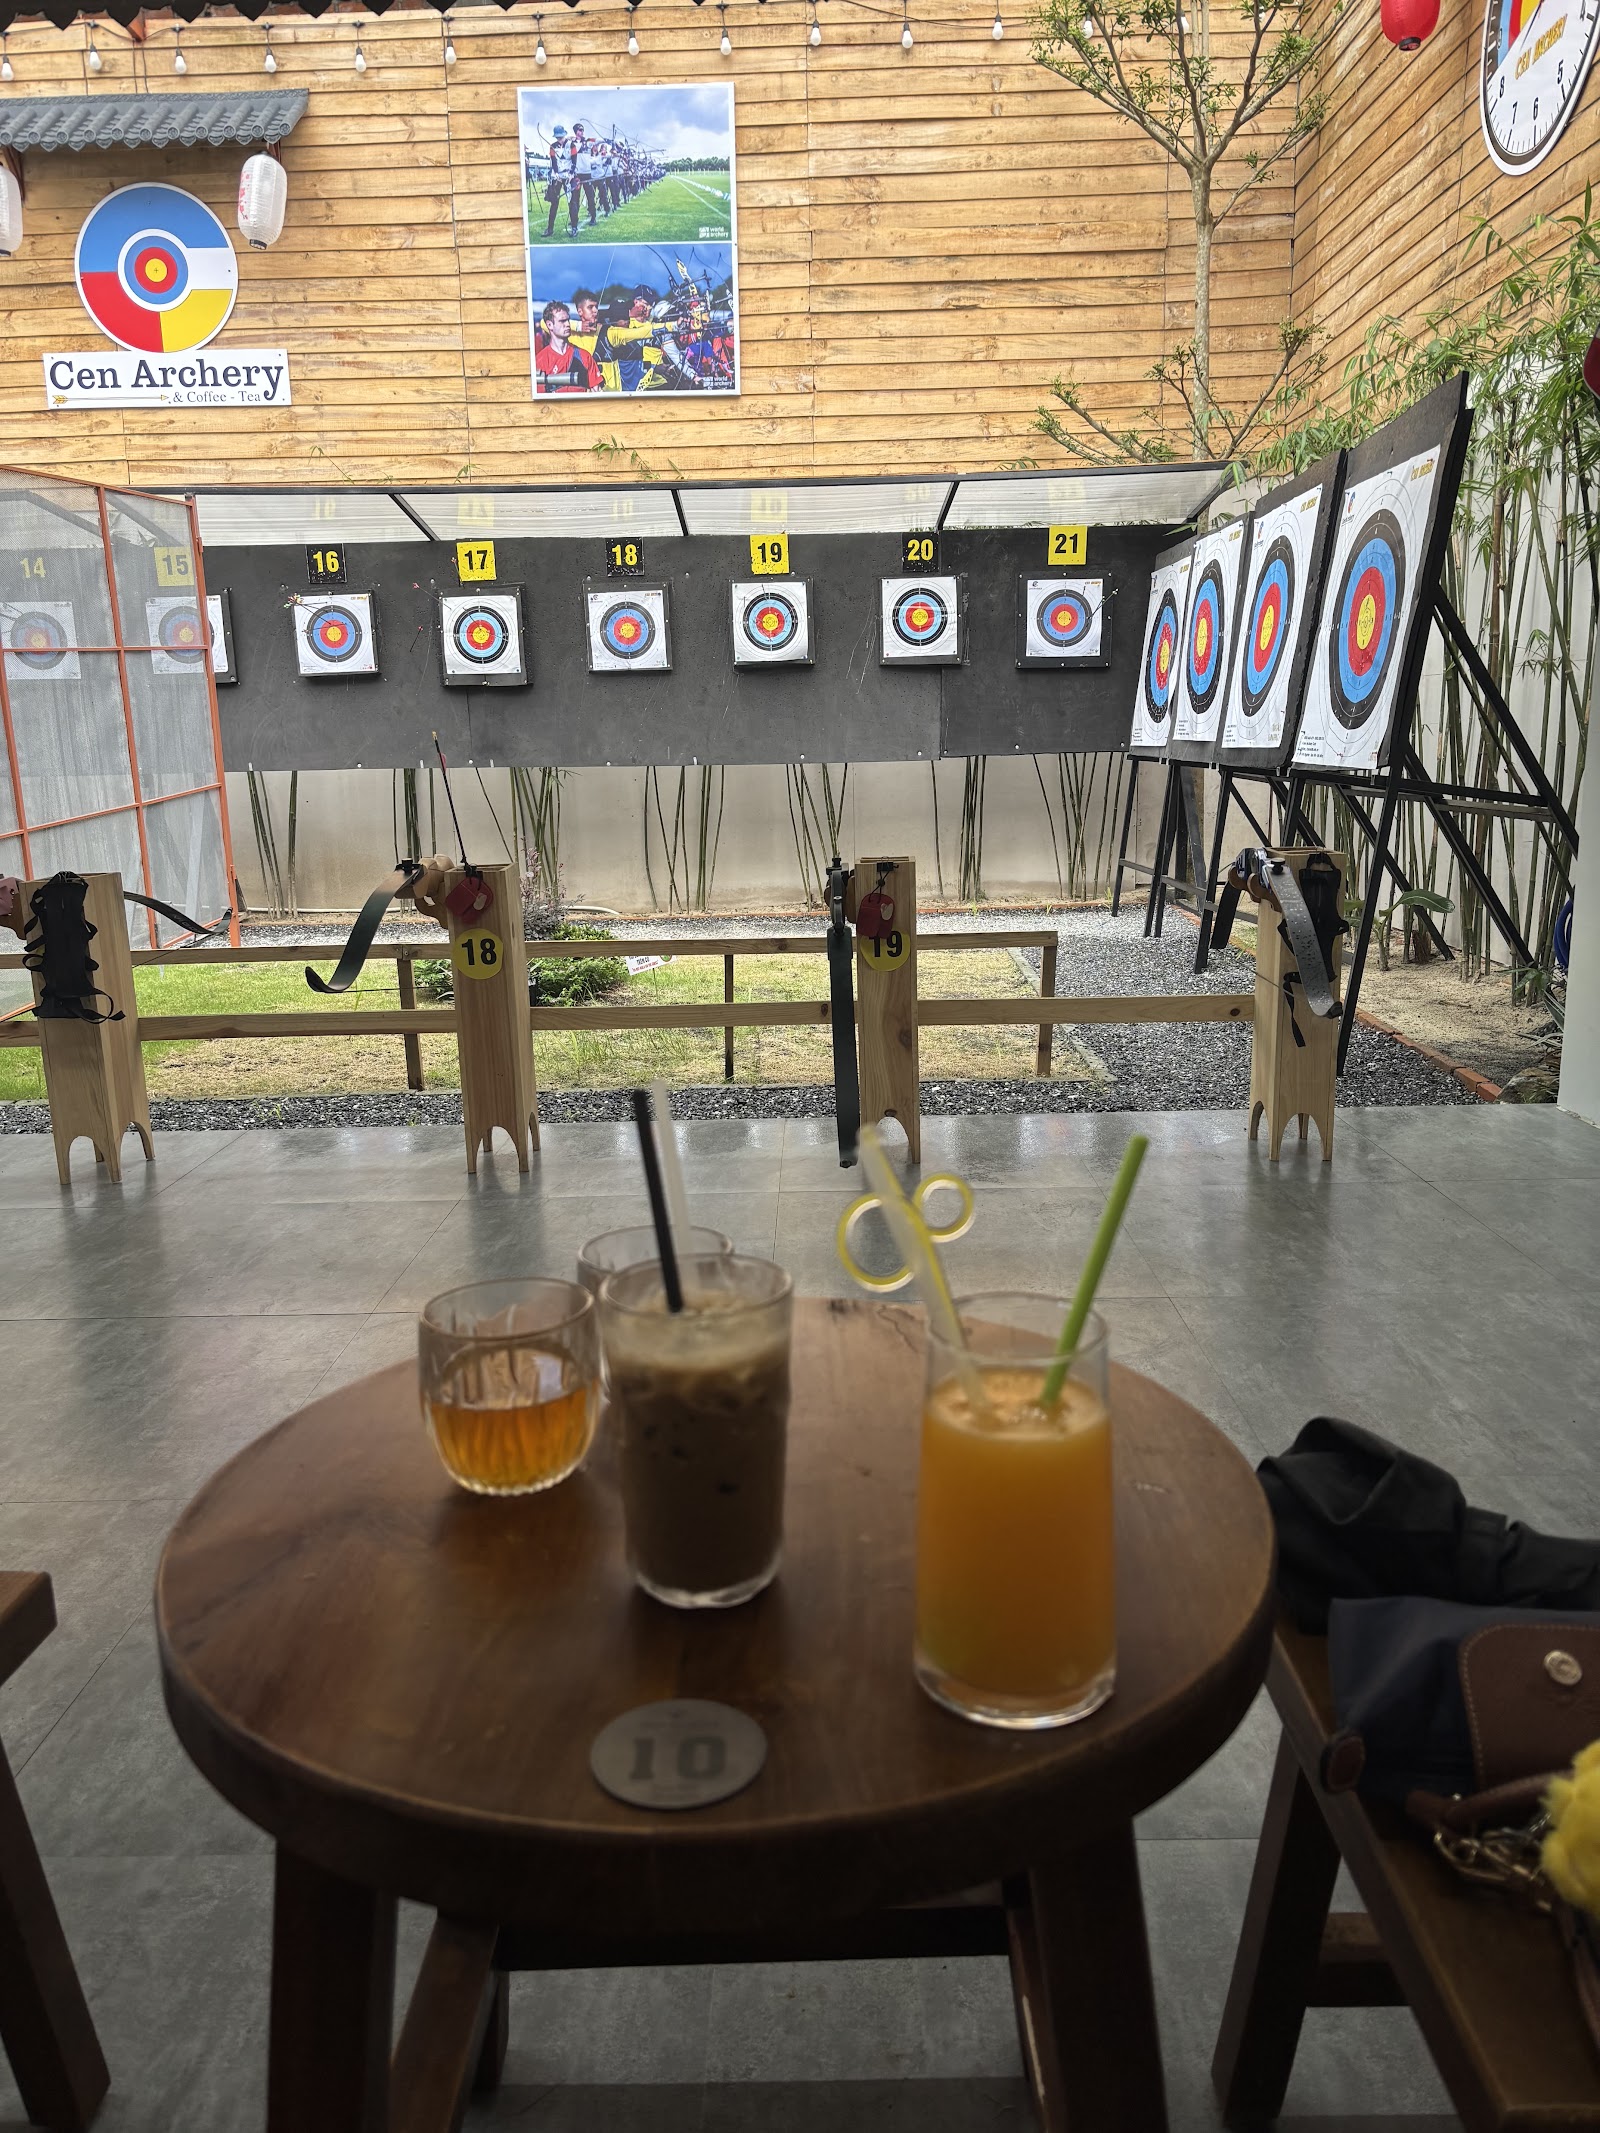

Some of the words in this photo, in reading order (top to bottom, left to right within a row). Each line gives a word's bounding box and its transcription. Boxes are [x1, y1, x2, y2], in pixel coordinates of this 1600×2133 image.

[1556, 59, 1564, 85] 5
[1499, 75, 1505, 98] 8
[1512, 101, 1518, 125] 7
[1532, 97, 1539, 121] 6
[50, 360, 122, 390] Cen
[131, 358, 284, 401] Archery
[172, 391, 183, 402] &
[187, 391, 226, 402] Coffee
[238, 390, 261, 402] Tea
[611, 543, 638, 566] 18
[757, 542, 783, 563] 19
[907, 538, 934, 561] 20
[1054, 533, 1080, 554] 21
[20, 556, 47, 579] 14
[162, 554, 189, 576] 15
[312, 550, 340, 573] 16
[464, 549, 488, 571] 17
[461, 938, 497, 966] 18
[868, 930, 903, 958] 19
[628, 1735, 727, 1781] 10
